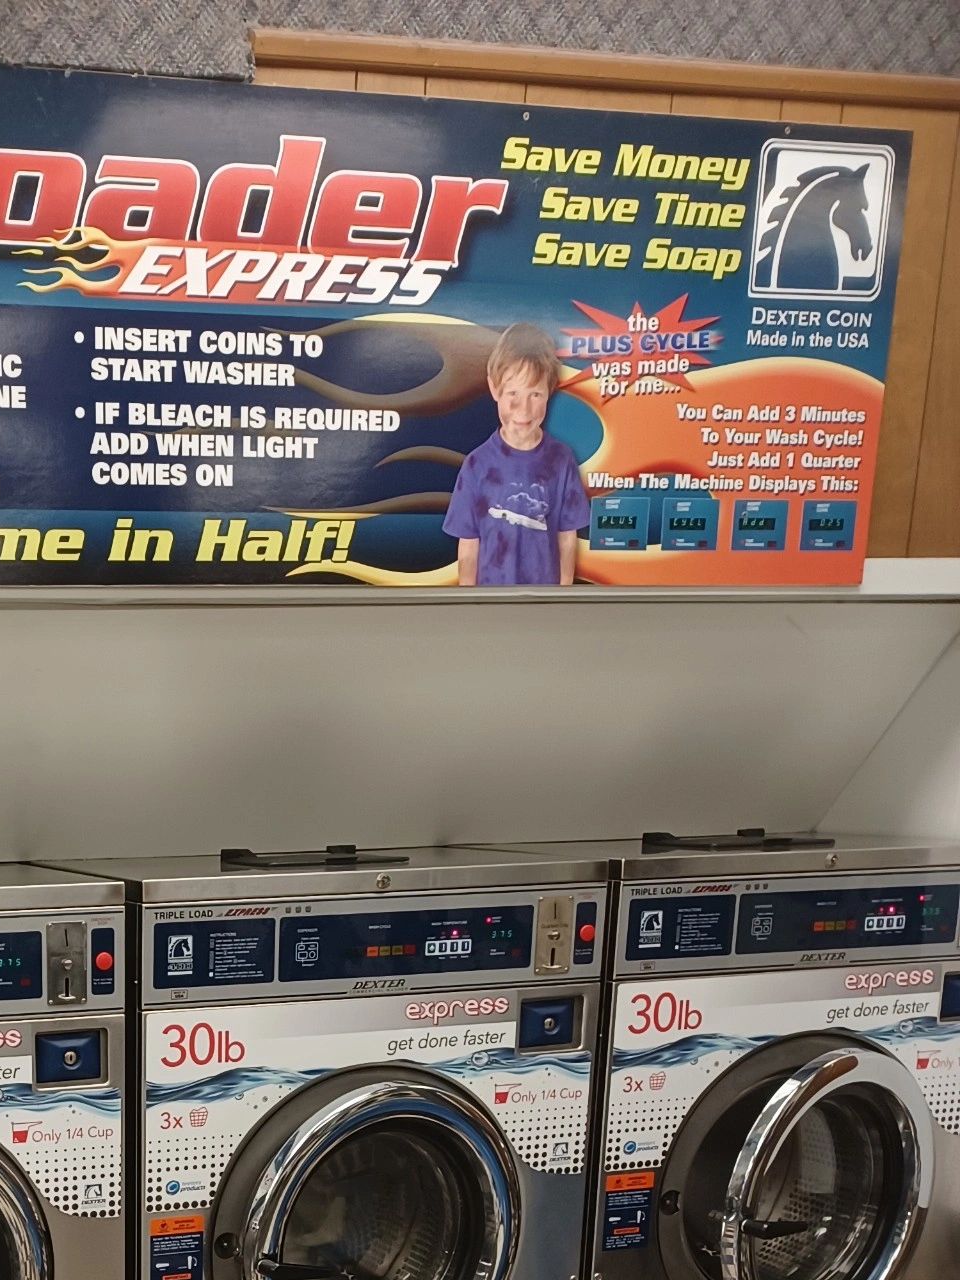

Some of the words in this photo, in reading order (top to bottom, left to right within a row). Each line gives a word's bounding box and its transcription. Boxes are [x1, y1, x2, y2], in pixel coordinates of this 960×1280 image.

[501, 136, 602, 175] Save
[613, 143, 751, 191] Money
[539, 187, 640, 223] Save
[654, 192, 746, 228] Time
[532, 233, 631, 269] Save
[642, 238, 743, 280] Soap
[118, 246, 448, 305] EXPRESS
[626, 313, 659, 333] the
[751, 307, 821, 326] DEXTER
[826, 308, 872, 328] COIN
[94, 326, 192, 354] INSERT
[199, 330, 283, 357] COINS
[290, 334, 324, 358] TO
[571, 334, 633, 354] PLUS
[640, 331, 711, 351] CYCLE
[746, 329, 788, 348] Made
[791, 331, 805, 347] in
[809, 331, 833, 348] the
[837, 332, 869, 349] USA
[90, 358, 177, 384] START
[183, 361, 295, 387] WASHER
[591, 360, 632, 377] was
[637, 355, 689, 376] made
[600, 377, 628, 397] for
[635, 379, 681, 395] me...
[95, 402, 120, 425] IF
[128, 403, 232, 428] BLEACH
[240, 405, 267, 429] IS
[274, 406, 401, 432] REQUIRED
[676, 403, 709, 421] You
[711, 405, 743, 421] Can
[747, 405, 779, 422] Add
[784, 406, 796, 421] 3
[801, 406, 866, 423] Minutes
[90, 432, 149, 456] ADD
[155, 433, 234, 457] WHEN
[242, 435, 319, 459] LIGHT
[701, 428, 720, 444] To
[725, 429, 761, 445] Your
[765, 429, 808, 446] Wash
[813, 430, 864, 448] Cycle!
[707, 451, 744, 467] Just
[747, 452, 780, 468] Add
[786, 453, 795, 468] 1
[801, 453, 861, 469] Quarter
[91, 462, 188, 487] COMES
[195, 464, 234, 487] ON
[588, 473, 634, 489] When
[639, 473, 669, 490] The
[674, 474, 743, 491] Machine
[748, 474, 816, 494] Displays
[820, 475, 858, 491] This:
[107, 518, 174, 562] in
[194, 519, 356, 563] Half!
[631, 888, 658, 896] TRIPLE
[660, 886, 683, 895] LOAD
[154, 911, 185, 920] TRIPLE
[189, 910, 214, 918] LOAD
[800, 952, 847, 962] DEXTER
[352, 979, 406, 990] DEXTER
[844, 968, 935, 996] express
[405, 997, 510, 1026] express
[627, 991, 703, 1035] 30lb
[826, 1005, 850, 1024] get
[853, 1002, 888, 1019] done
[892, 999, 930, 1015] faster
[160, 1022, 247, 1068] 30lb
[387, 1037, 414, 1056] get
[418, 1033, 458, 1051] done
[462, 1030, 506, 1047] faster
[931, 1056, 954, 1070] Only
[623, 1076, 644, 1093] 3x
[511, 1091, 537, 1104] Only
[541, 1089, 556, 1101] 1/4
[560, 1088, 582, 1101] Cup
[160, 1112, 183, 1130] 3x
[32, 1129, 62, 1144] Only
[66, 1128, 84, 1140] 1/4
[88, 1126, 113, 1140] Cup
